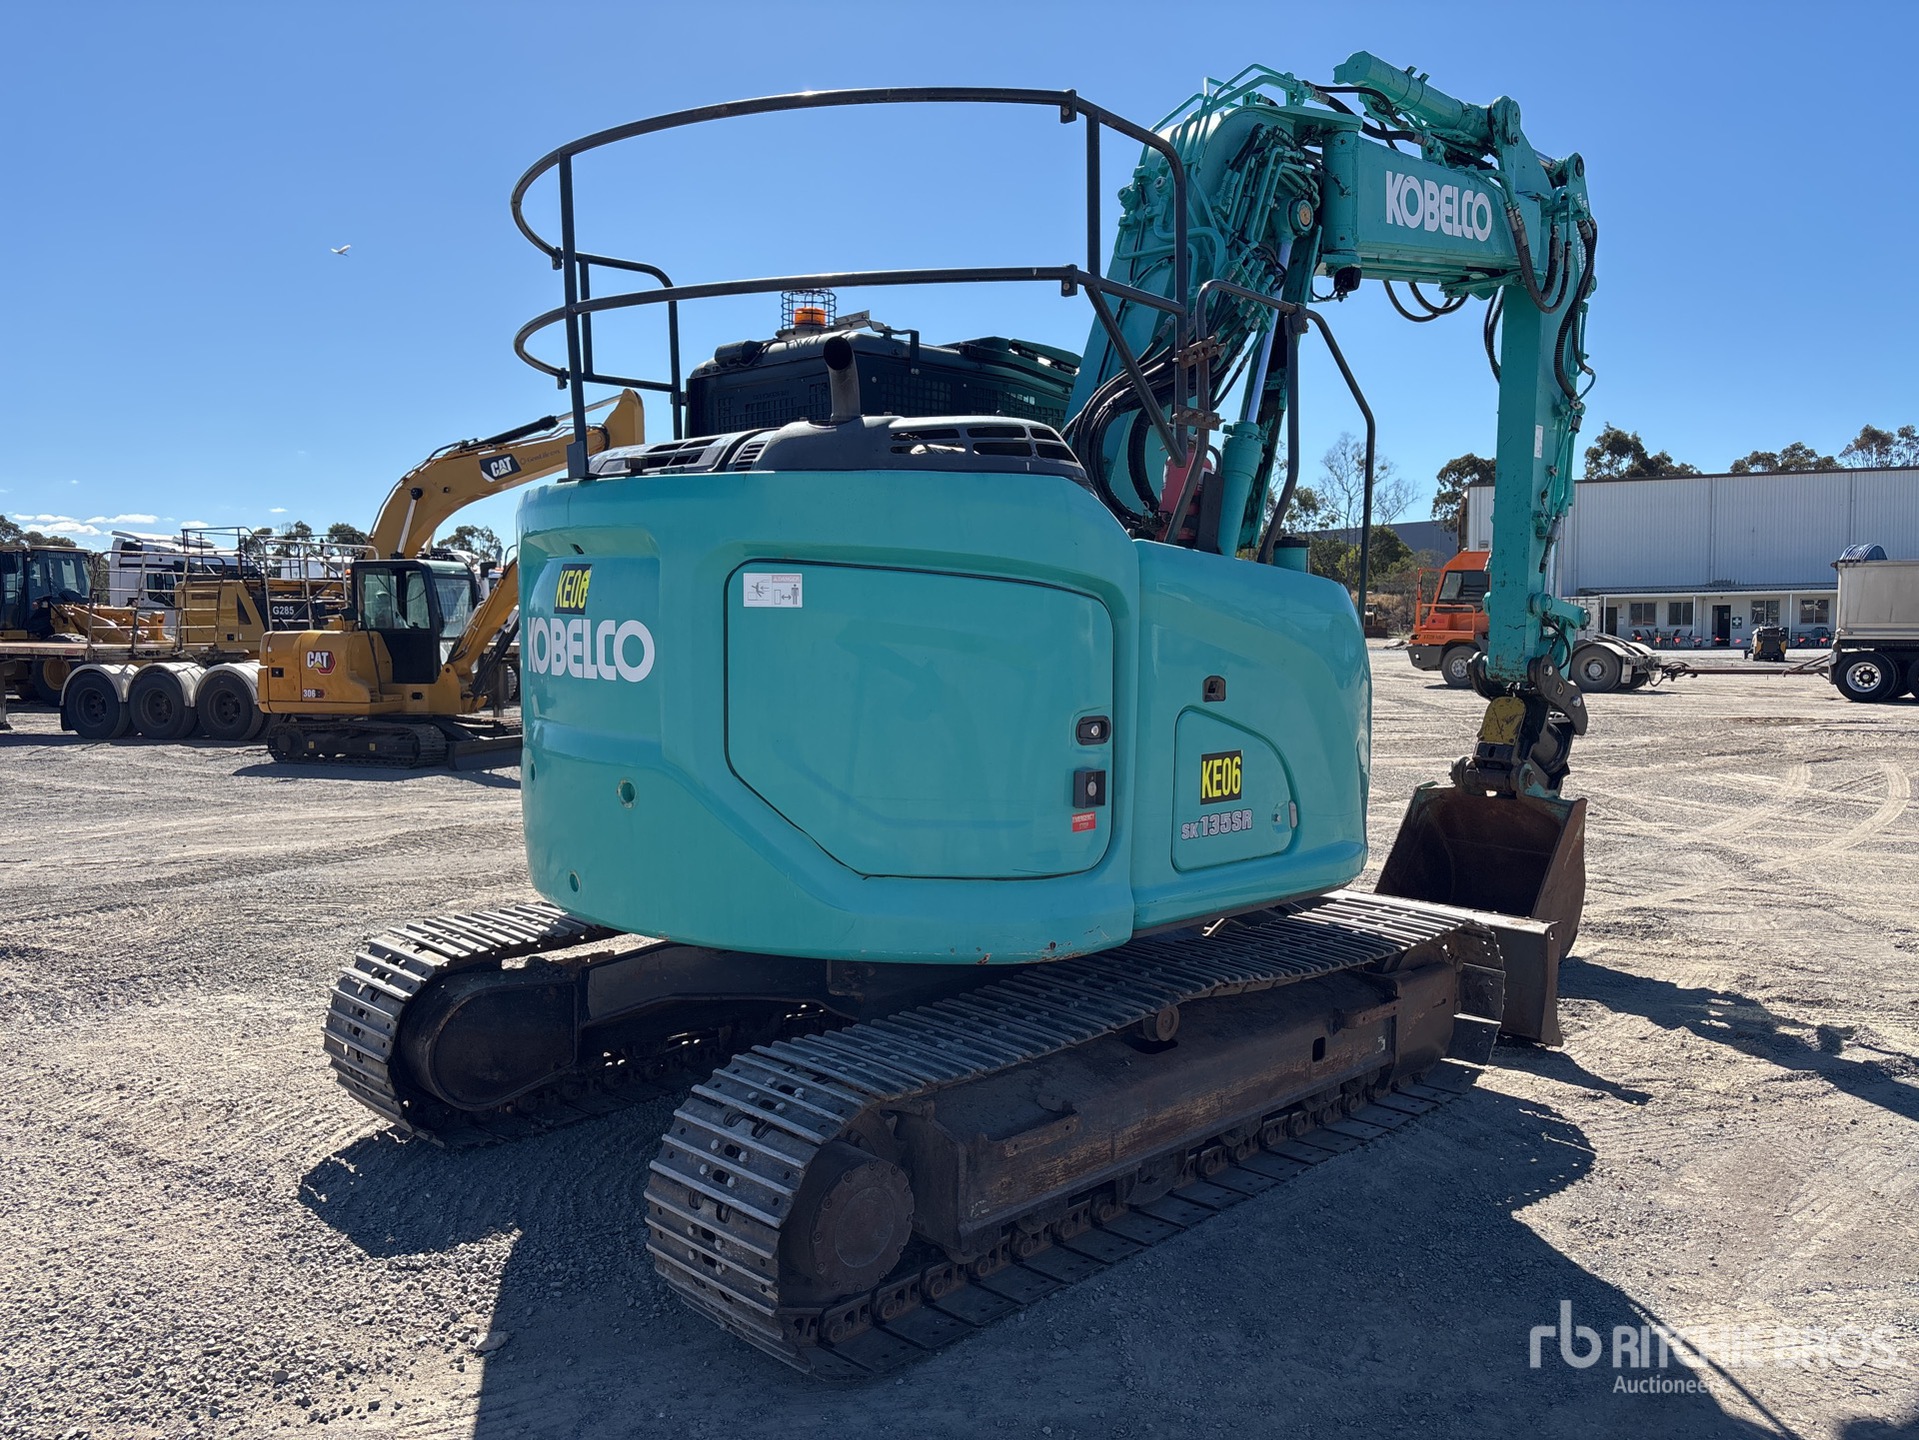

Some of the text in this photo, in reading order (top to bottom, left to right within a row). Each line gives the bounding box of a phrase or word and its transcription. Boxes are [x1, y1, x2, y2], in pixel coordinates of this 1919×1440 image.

[1385, 170, 1493, 242] KOBELCO
[490, 456, 513, 478] CAT
[272, 606, 295, 615] G285
[307, 651, 329, 668] CAT
[527, 617, 655, 683] KOBELCO
[303, 689, 316, 698] 306
[1202, 756, 1241, 799] KE06
